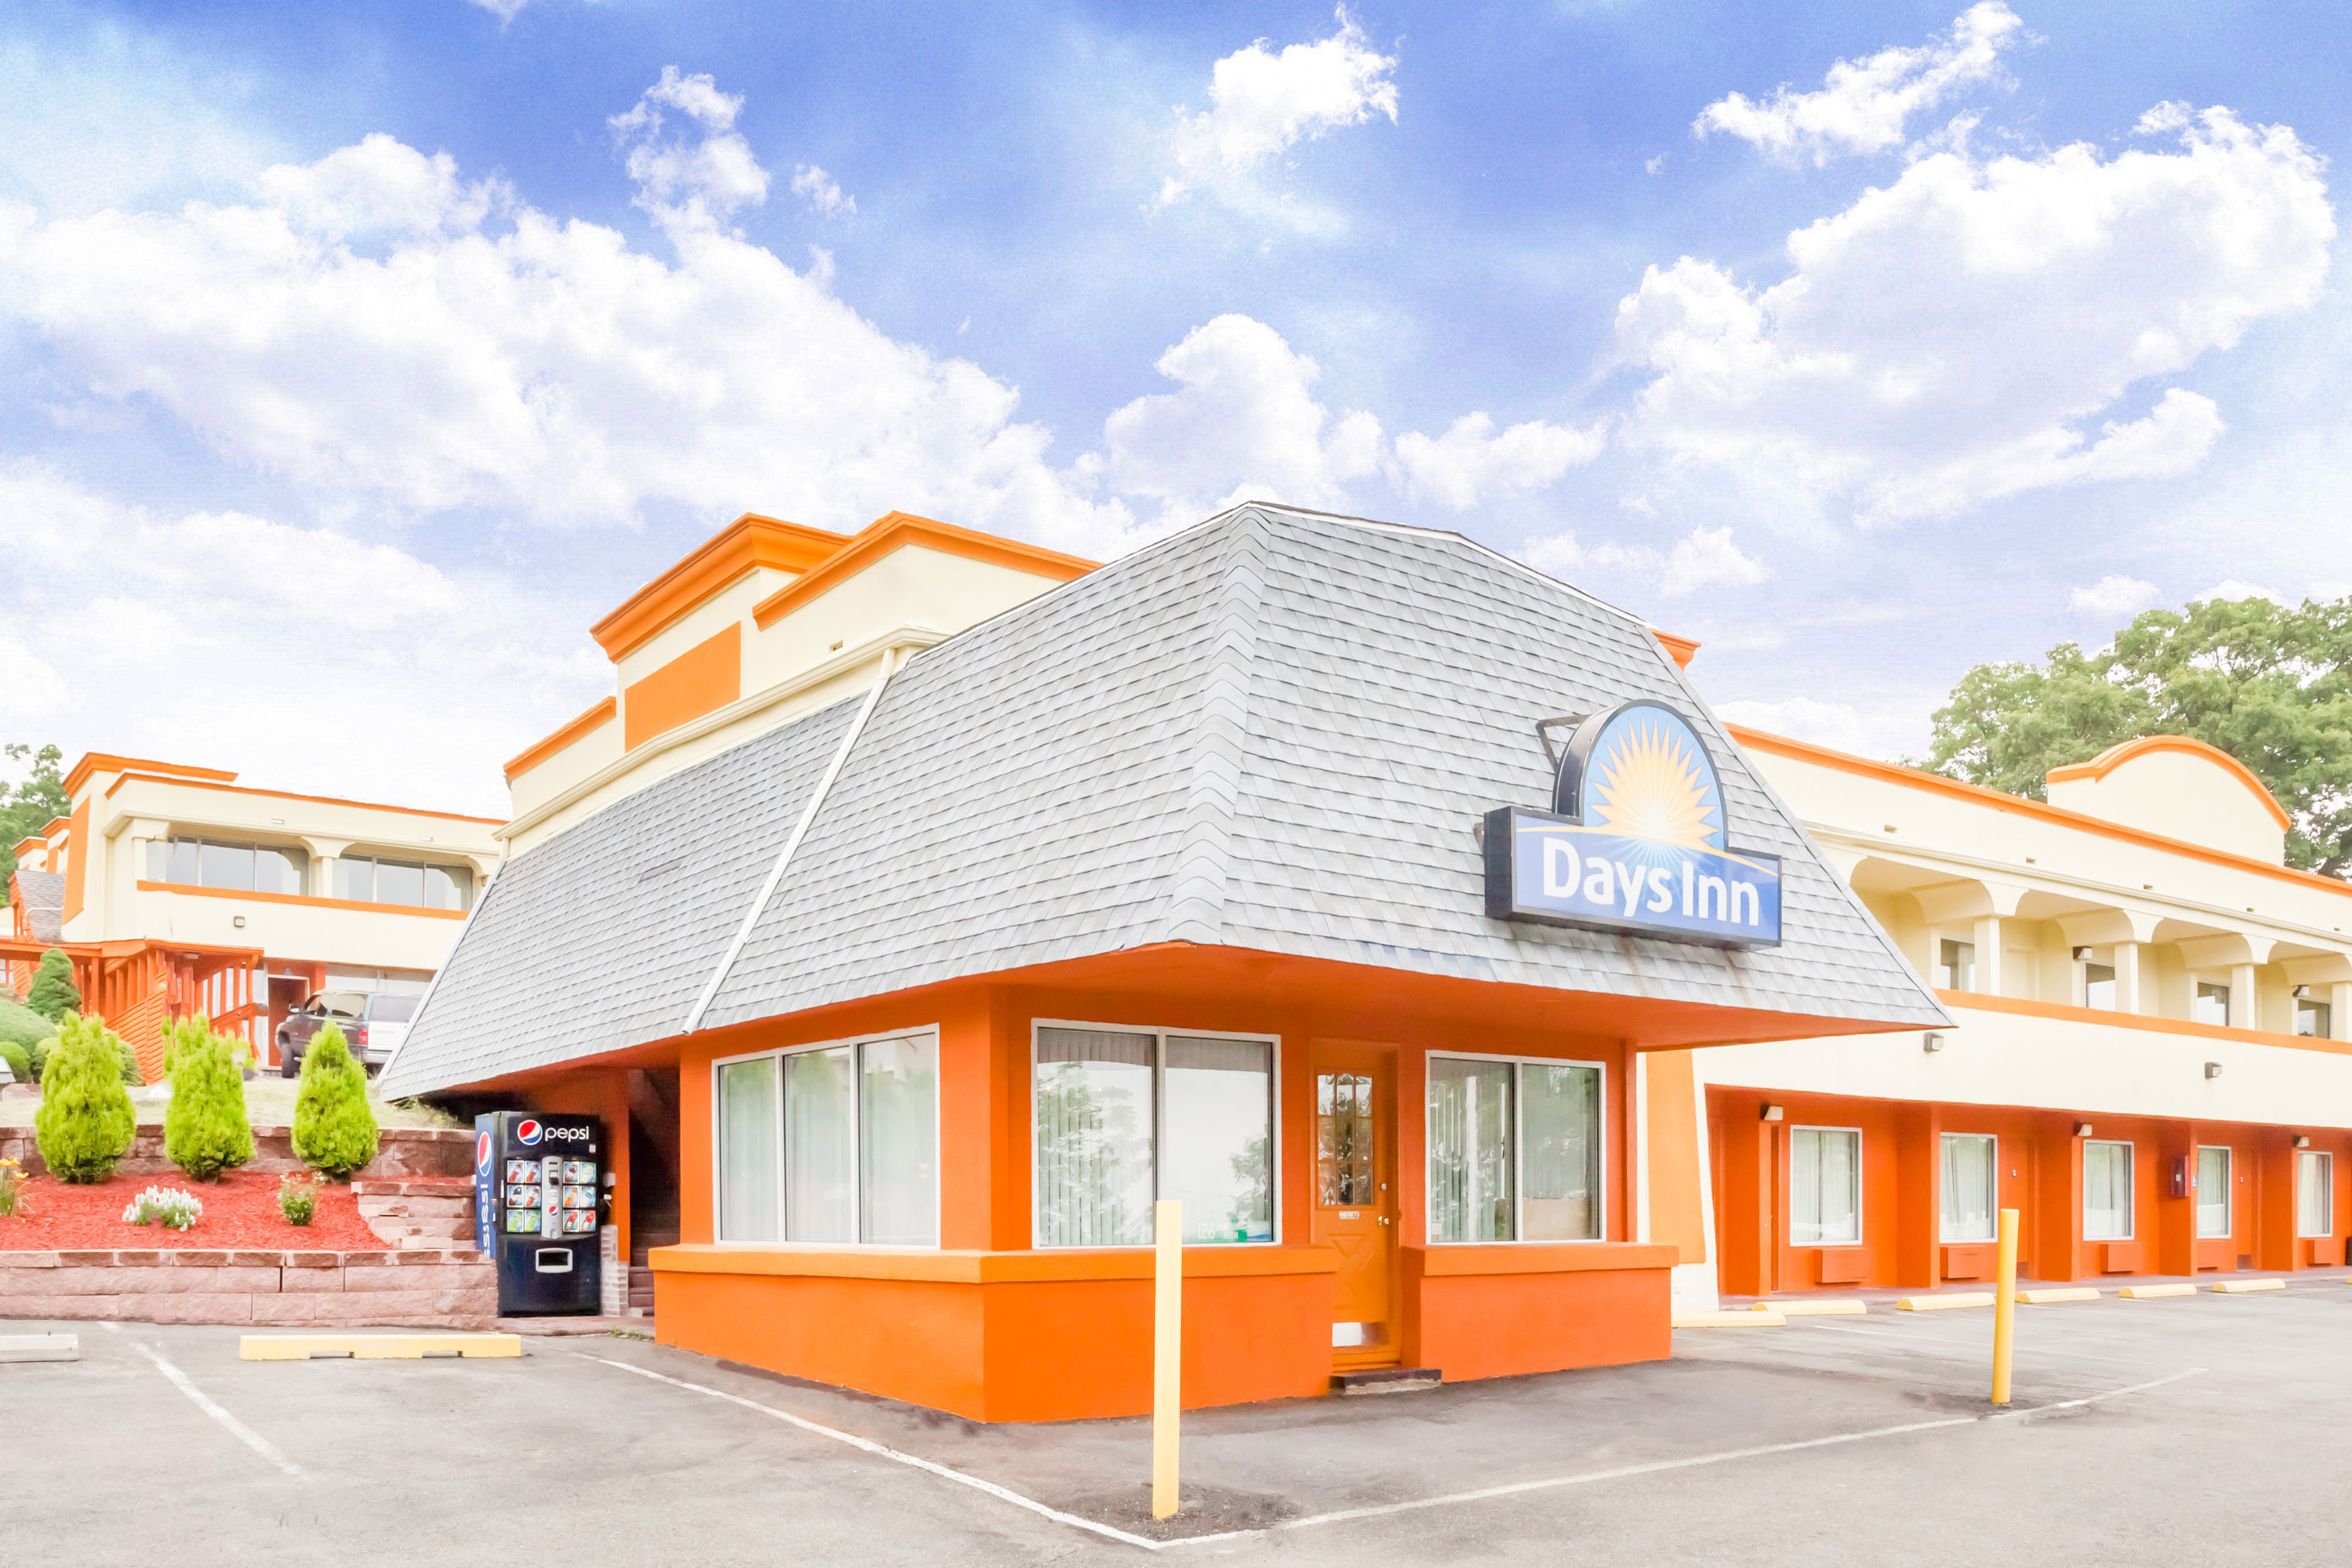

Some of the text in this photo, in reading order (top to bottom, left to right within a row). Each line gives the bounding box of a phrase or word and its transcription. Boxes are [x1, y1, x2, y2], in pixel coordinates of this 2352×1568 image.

[1543, 837, 1759, 926] Days Inn
[544, 1126, 590, 1142] pepsi
